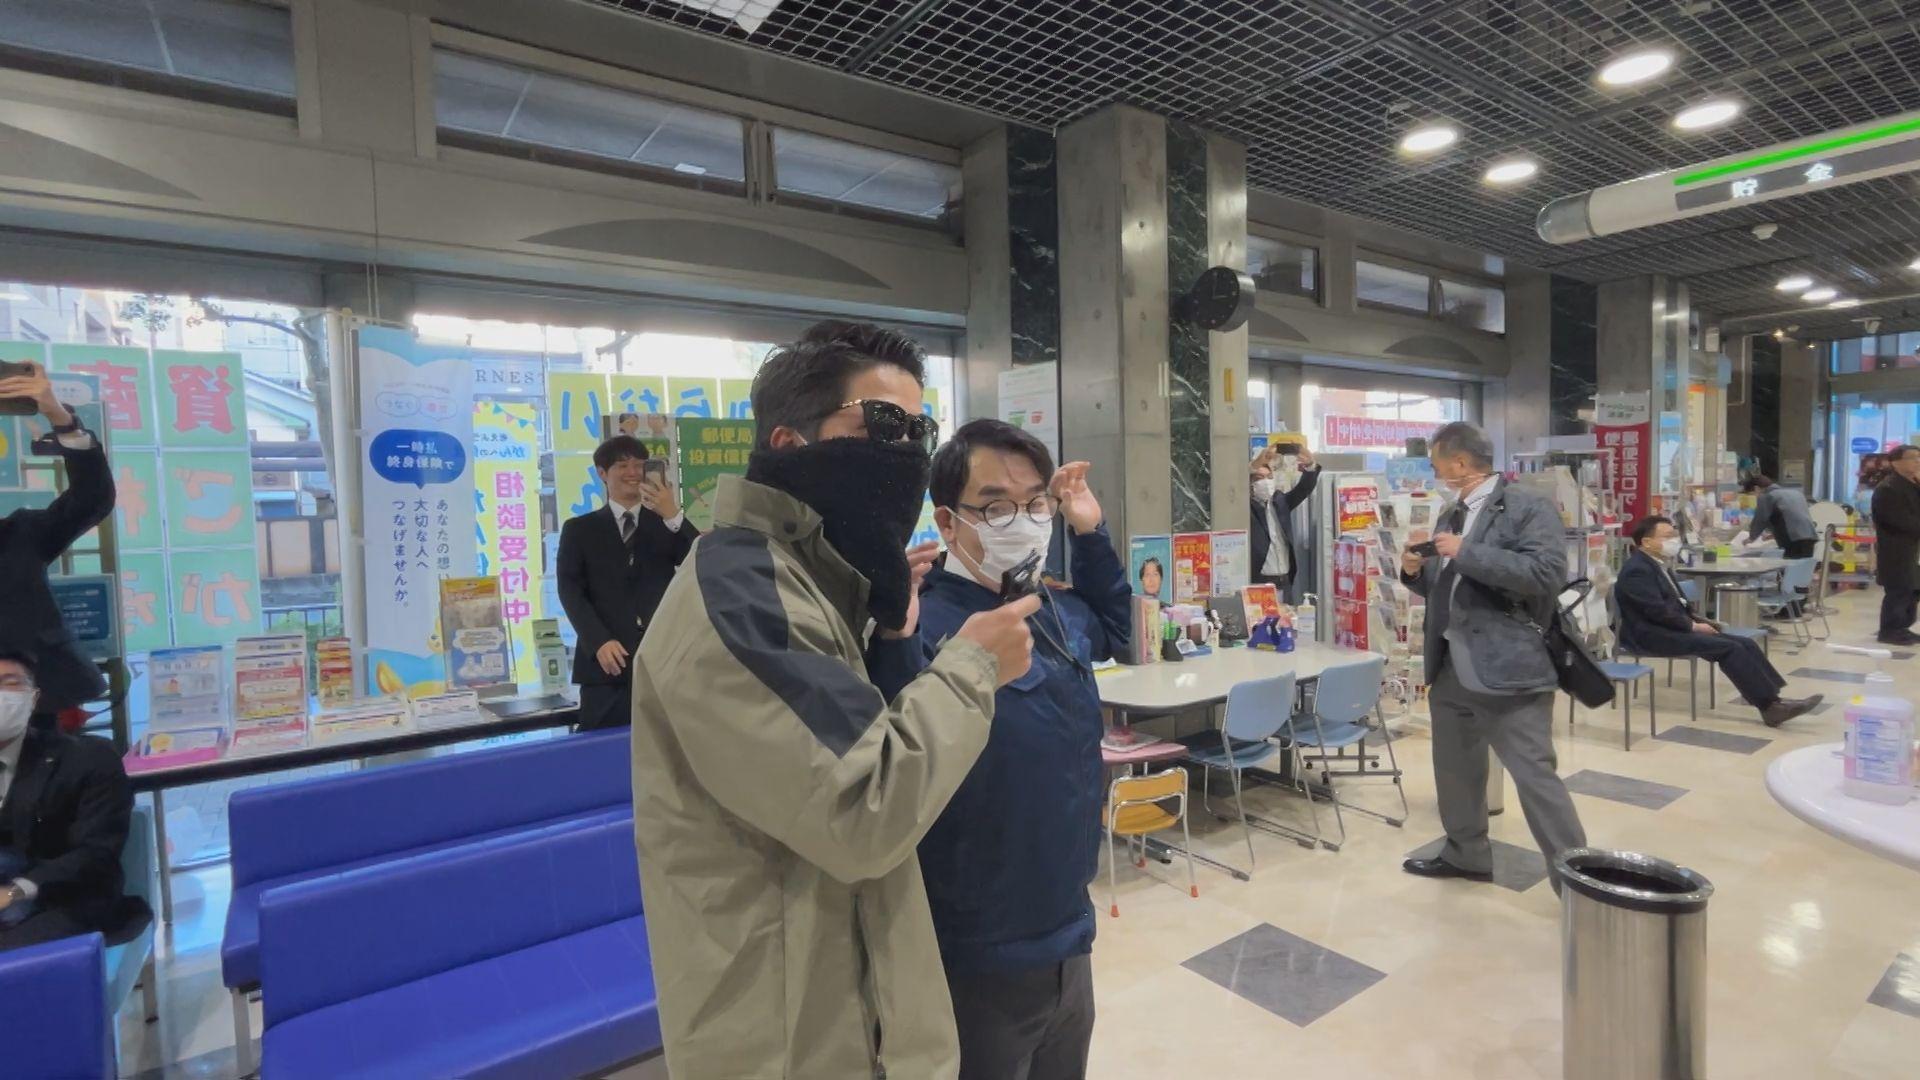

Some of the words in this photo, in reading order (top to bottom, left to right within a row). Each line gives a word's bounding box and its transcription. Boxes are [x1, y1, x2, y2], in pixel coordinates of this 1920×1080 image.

[392, 500, 409, 608] つなげませんか。
[414, 500, 430, 569] 大切な人へ
